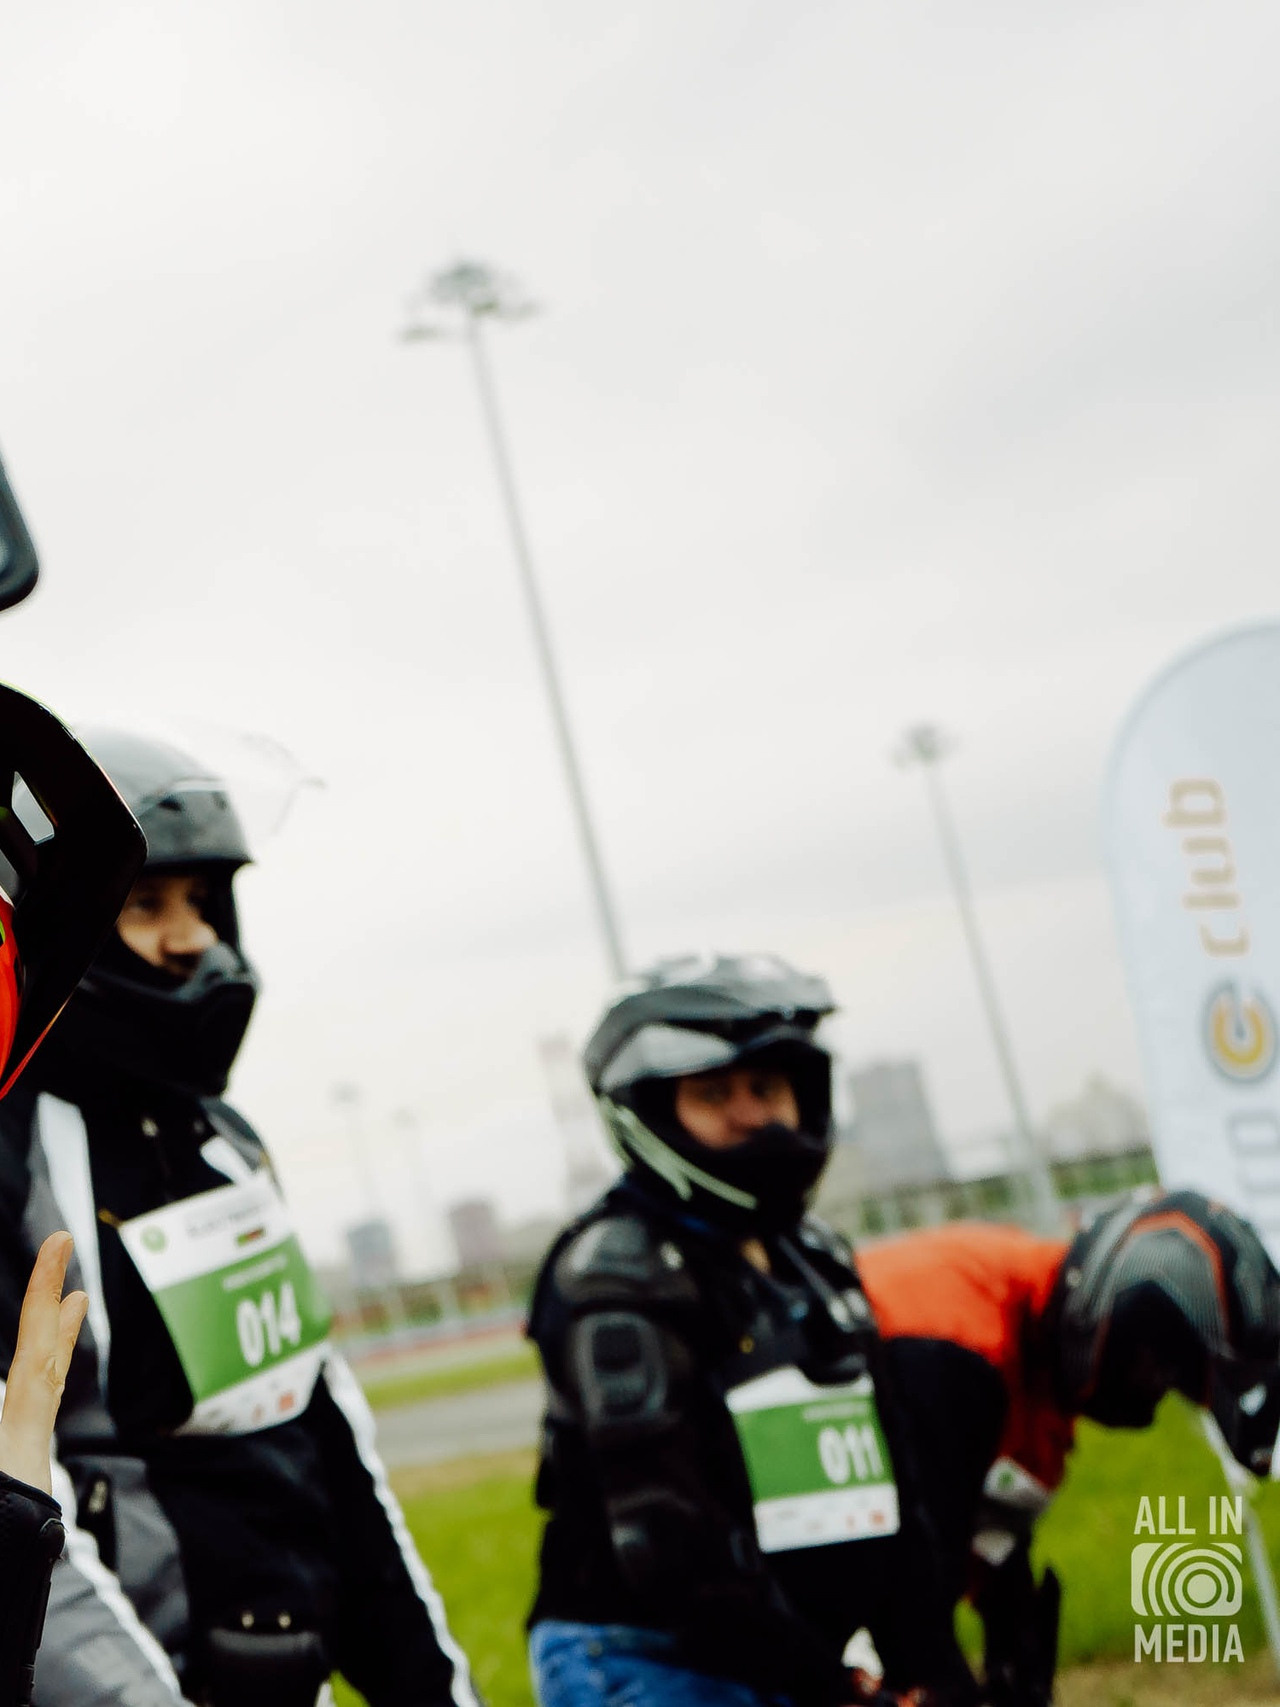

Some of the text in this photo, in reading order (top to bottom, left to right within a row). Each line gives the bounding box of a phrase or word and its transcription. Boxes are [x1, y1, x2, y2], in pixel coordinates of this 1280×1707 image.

[1162, 777, 1250, 958] club
[235, 1280, 302, 1368] 014
[818, 1423, 885, 1485] 011
